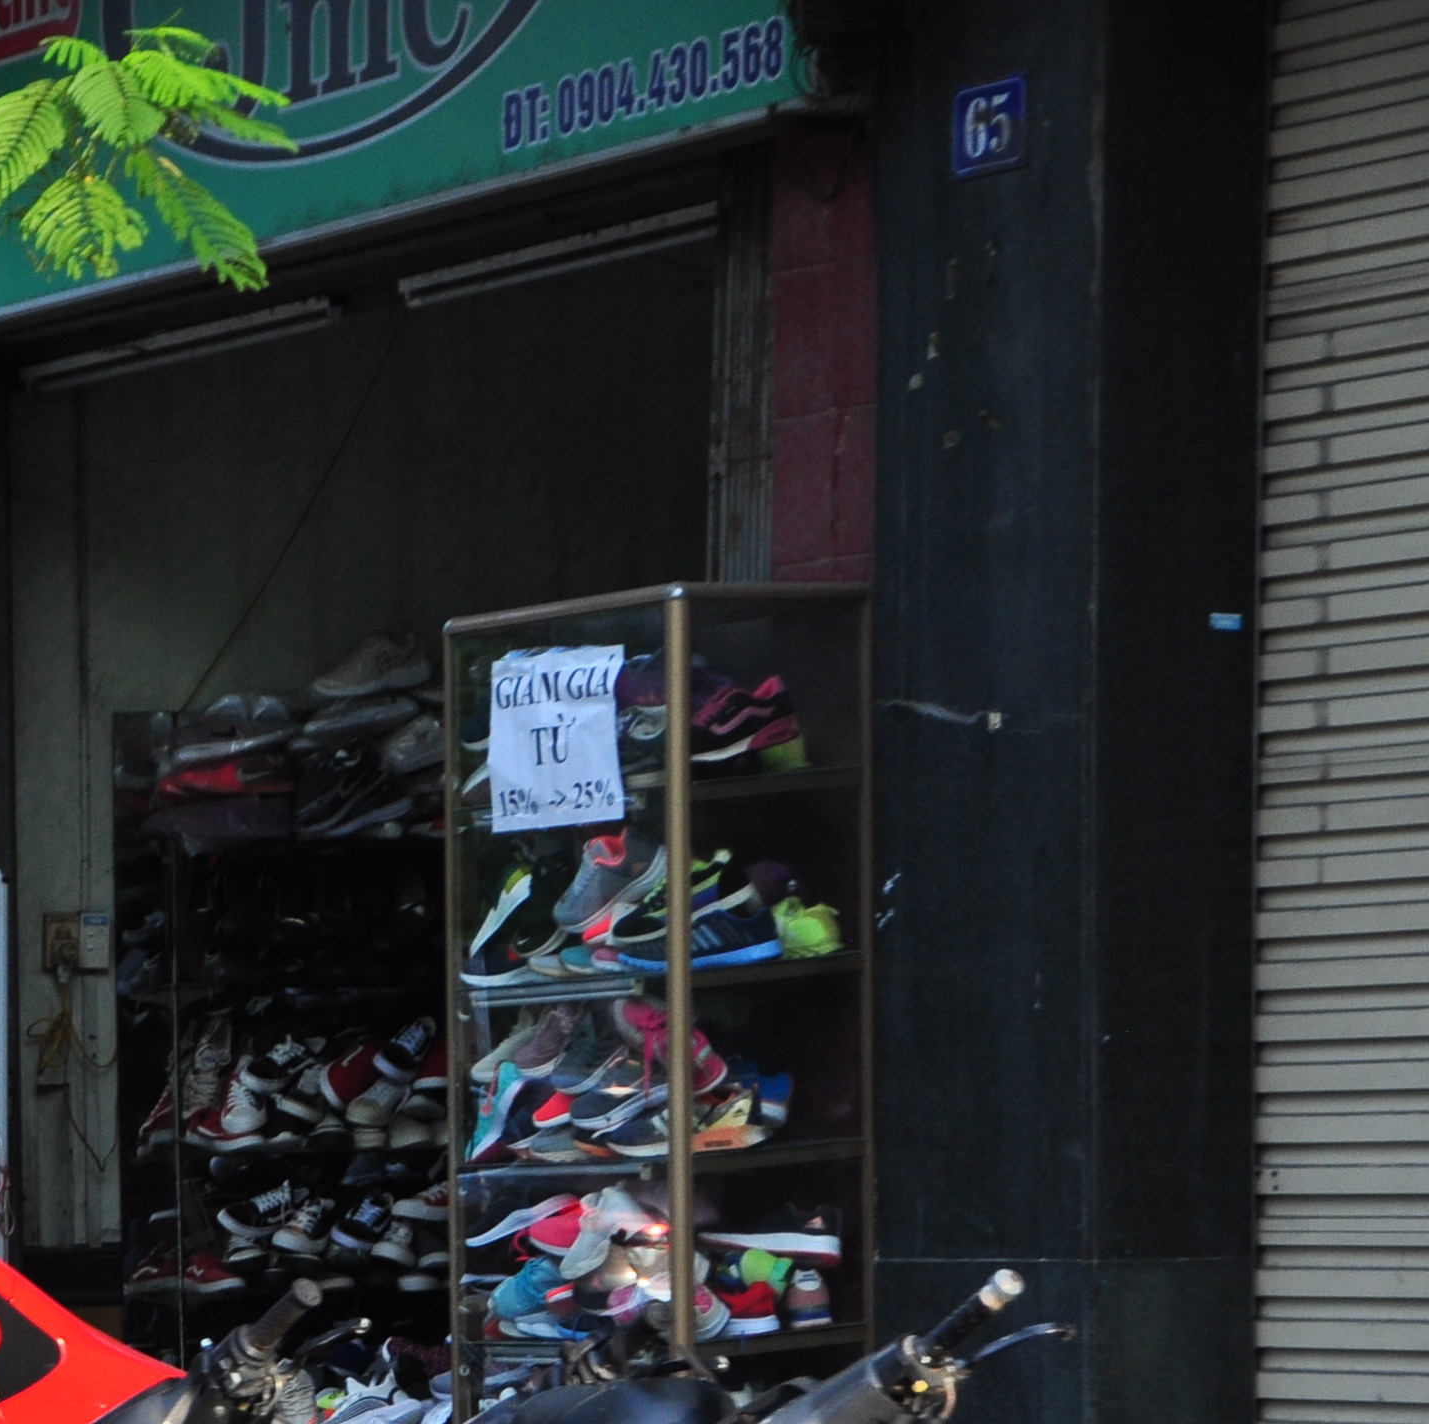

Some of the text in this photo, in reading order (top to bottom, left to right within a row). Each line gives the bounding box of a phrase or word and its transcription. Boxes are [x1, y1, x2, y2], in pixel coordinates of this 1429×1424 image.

[557, 16, 785, 136] 0904.430.568
[964, 91, 1010, 158] 65
[566, 654, 611, 701] GIÁ
[499, 778, 616, 818] 15% 25%
